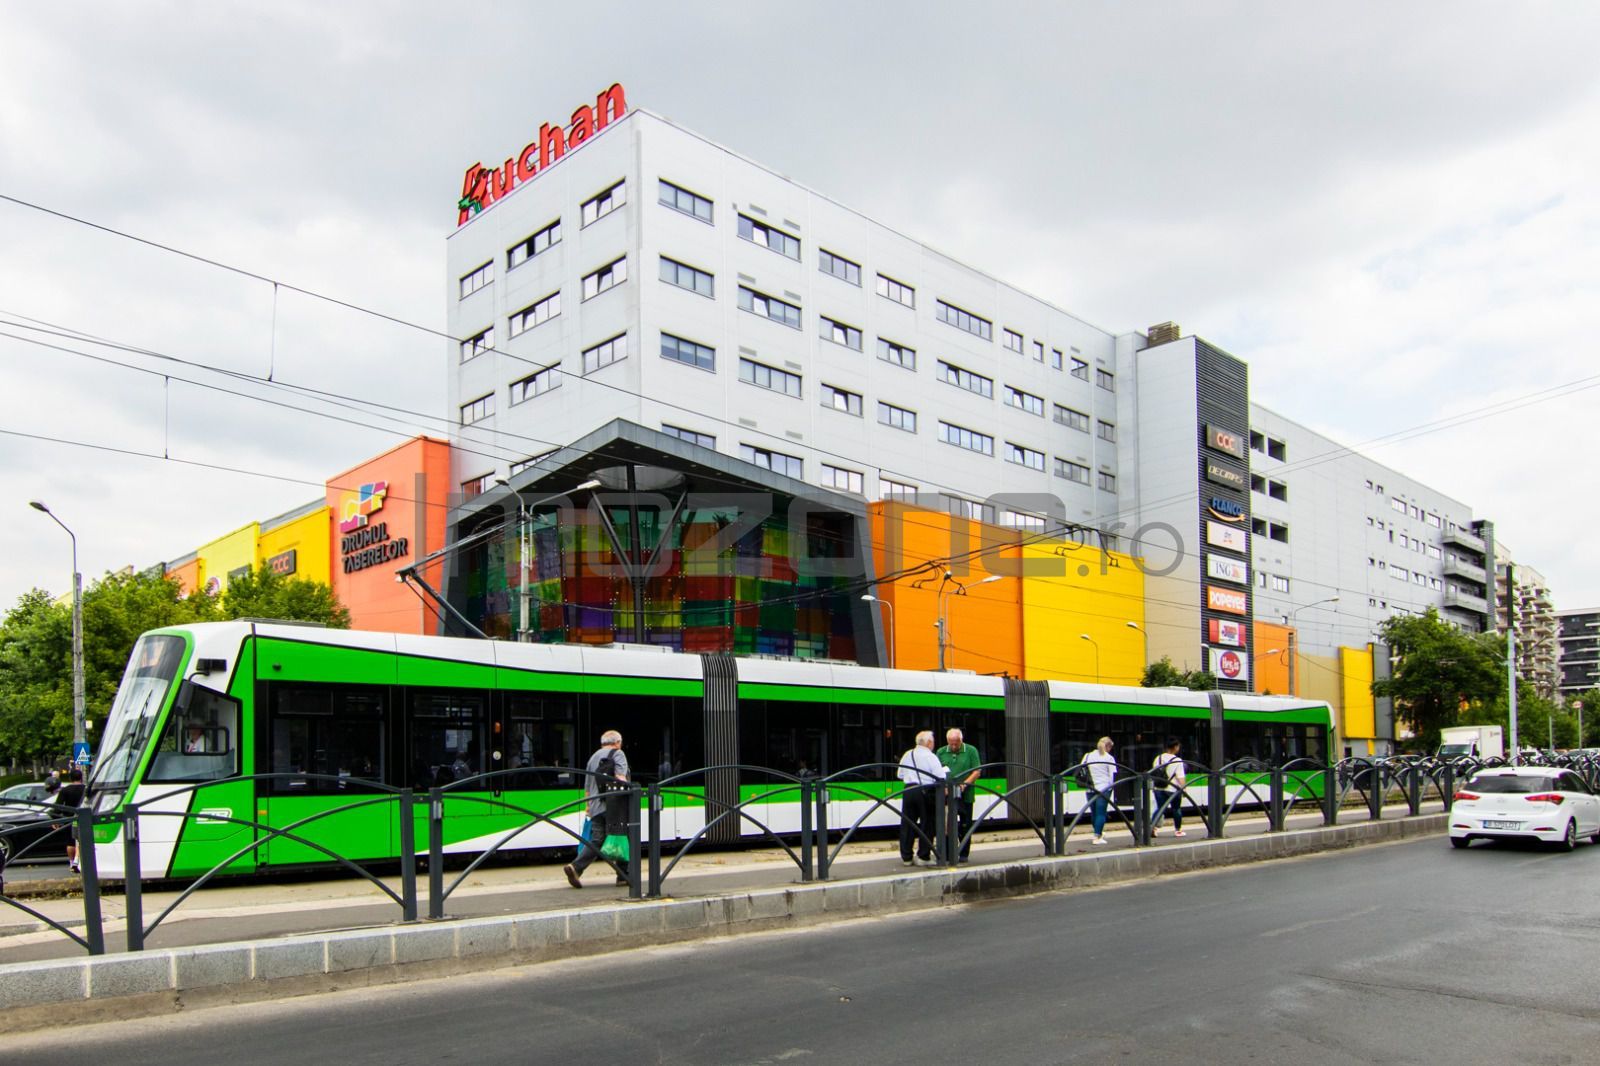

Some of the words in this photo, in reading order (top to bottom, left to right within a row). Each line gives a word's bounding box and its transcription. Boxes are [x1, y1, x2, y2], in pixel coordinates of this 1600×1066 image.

[458, 82, 625, 228] Auchan
[1216, 432, 1236, 451] CCC
[1212, 497, 1243, 515] FLANCO
[341, 522, 389, 556] DRUMUL
[342, 537, 409, 574] TABERELOR
[1215, 562, 1231, 577] ING
